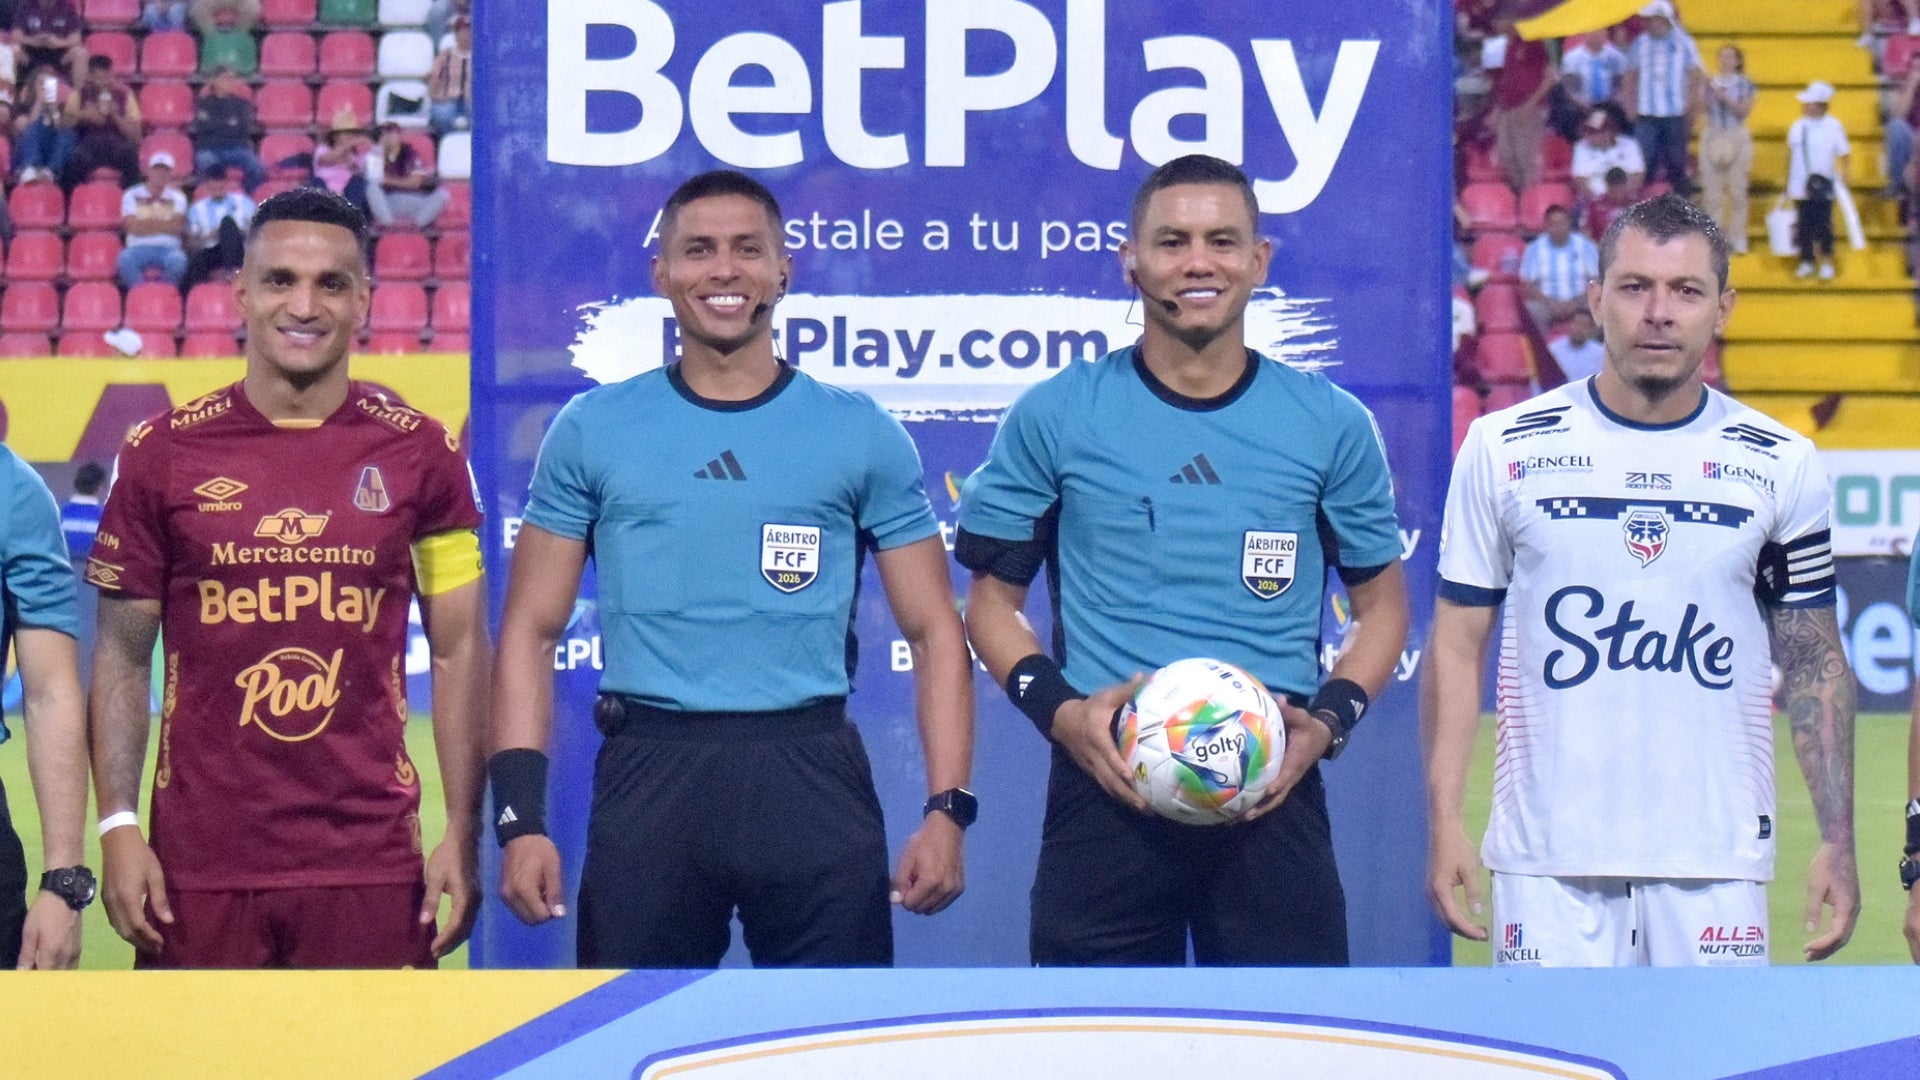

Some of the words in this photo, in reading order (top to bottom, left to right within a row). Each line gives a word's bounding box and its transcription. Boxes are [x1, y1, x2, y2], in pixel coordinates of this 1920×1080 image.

[547, 0, 1381, 215] BetPlay
[922, 220, 950, 251] a
[970, 213, 1013, 251] tu
[170, 396, 232, 429] Multi
[356, 398, 422, 431] Multi
[1526, 455, 1594, 469] GENCELL
[197, 501, 242, 513] umbro
[766, 528, 818, 545] ÁRBITRO
[1247, 535, 1296, 552] ÁRBITRO
[210, 542, 376, 566] Mercacentro
[774, 551, 807, 567] FCF
[1253, 557, 1285, 574] FCF
[777, 573, 801, 584] 2026
[1257, 581, 1279, 591] 2026
[197, 571, 387, 634] BetPlay
[1543, 585, 1735, 690] Stake
[235, 648, 344, 727] Pool
[1195, 736, 1243, 763] golty
[1698, 926, 1764, 941] ALLEN
